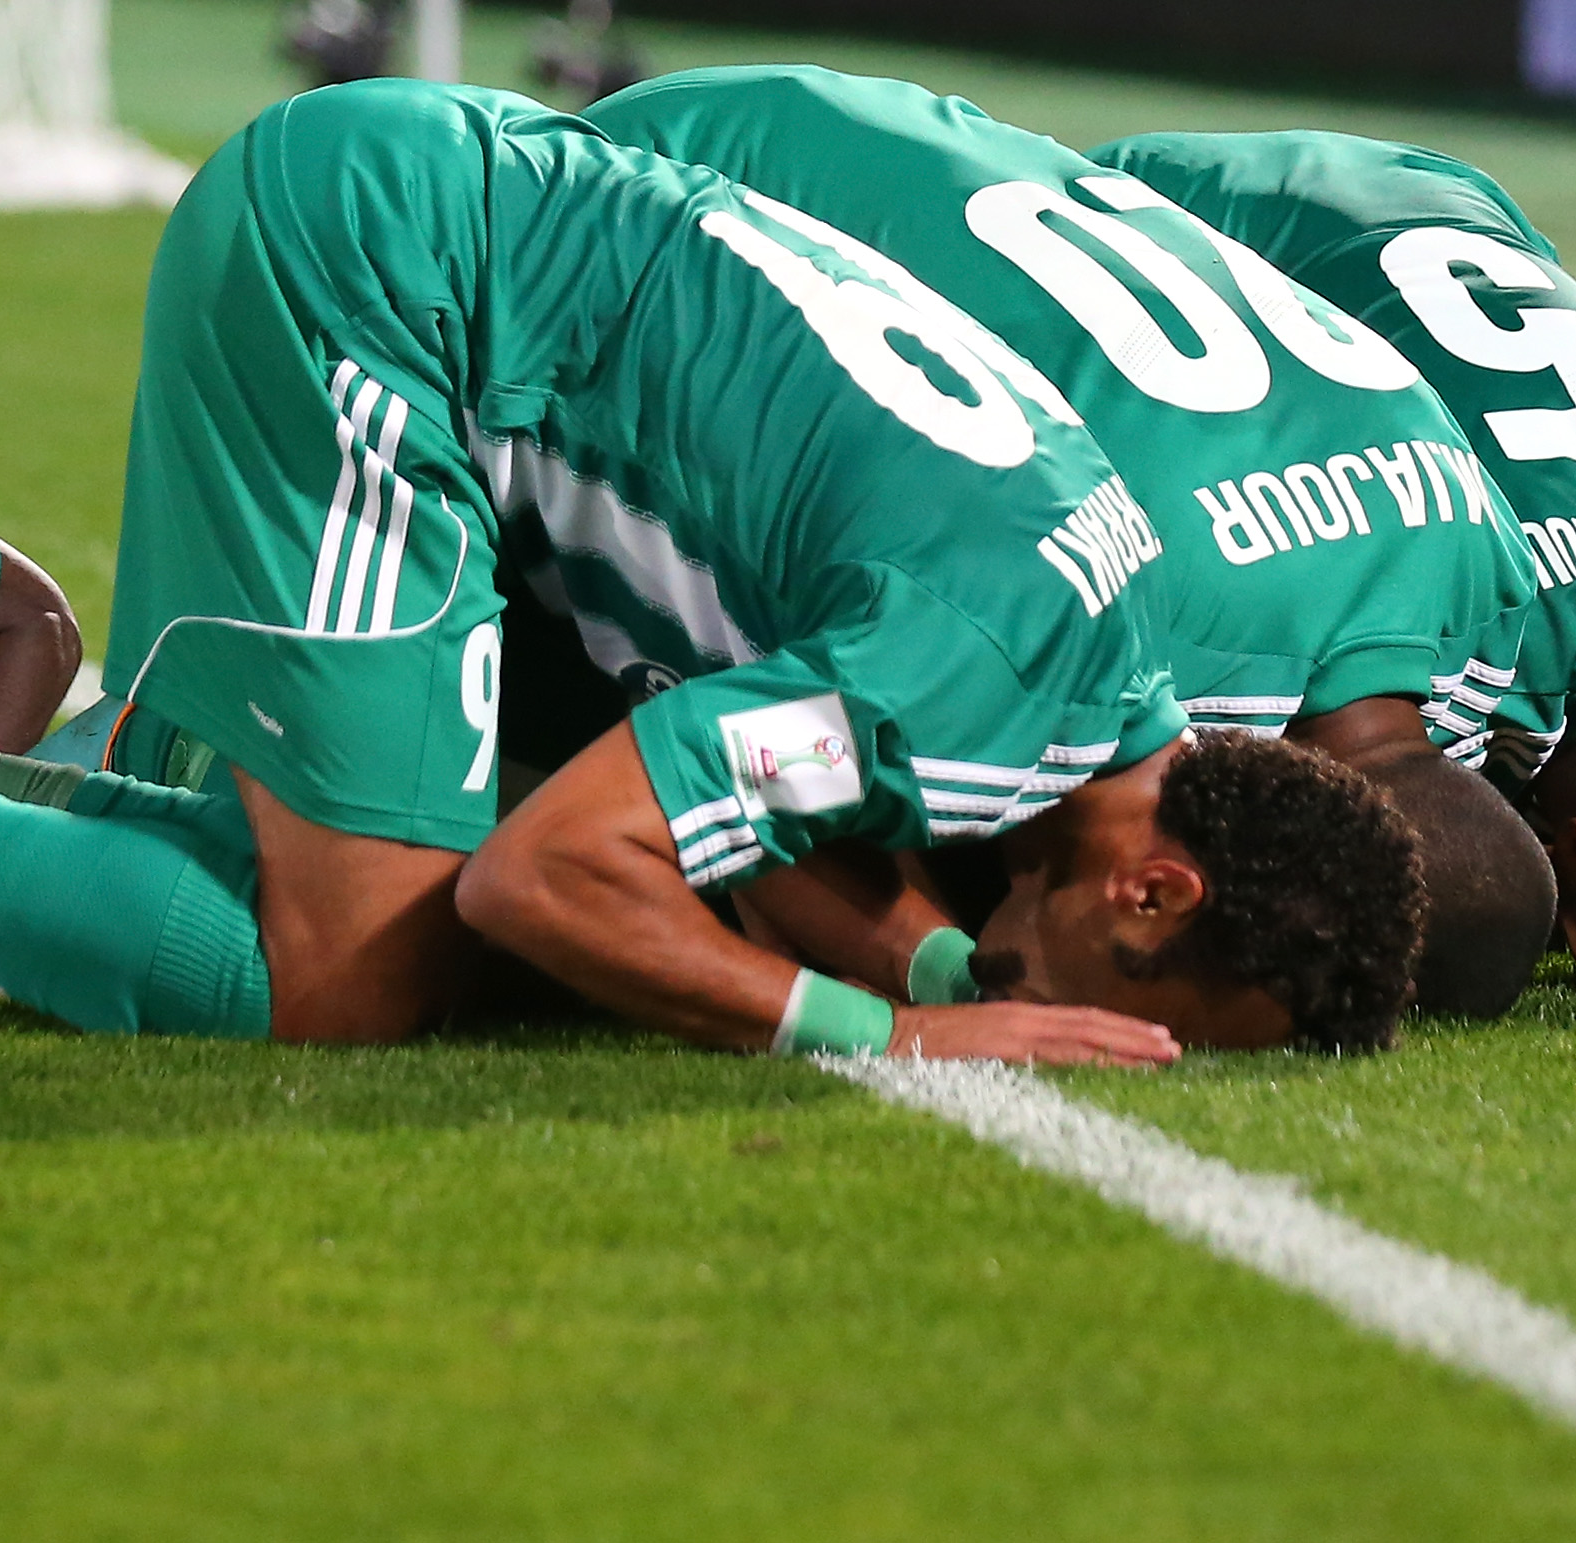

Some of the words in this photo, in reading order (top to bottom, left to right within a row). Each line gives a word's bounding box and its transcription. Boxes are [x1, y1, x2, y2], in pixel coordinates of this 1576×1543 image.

[964, 175, 1420, 413] 20
[1037, 473, 1164, 618] RRAKI
[460, 622, 503, 793] 9
